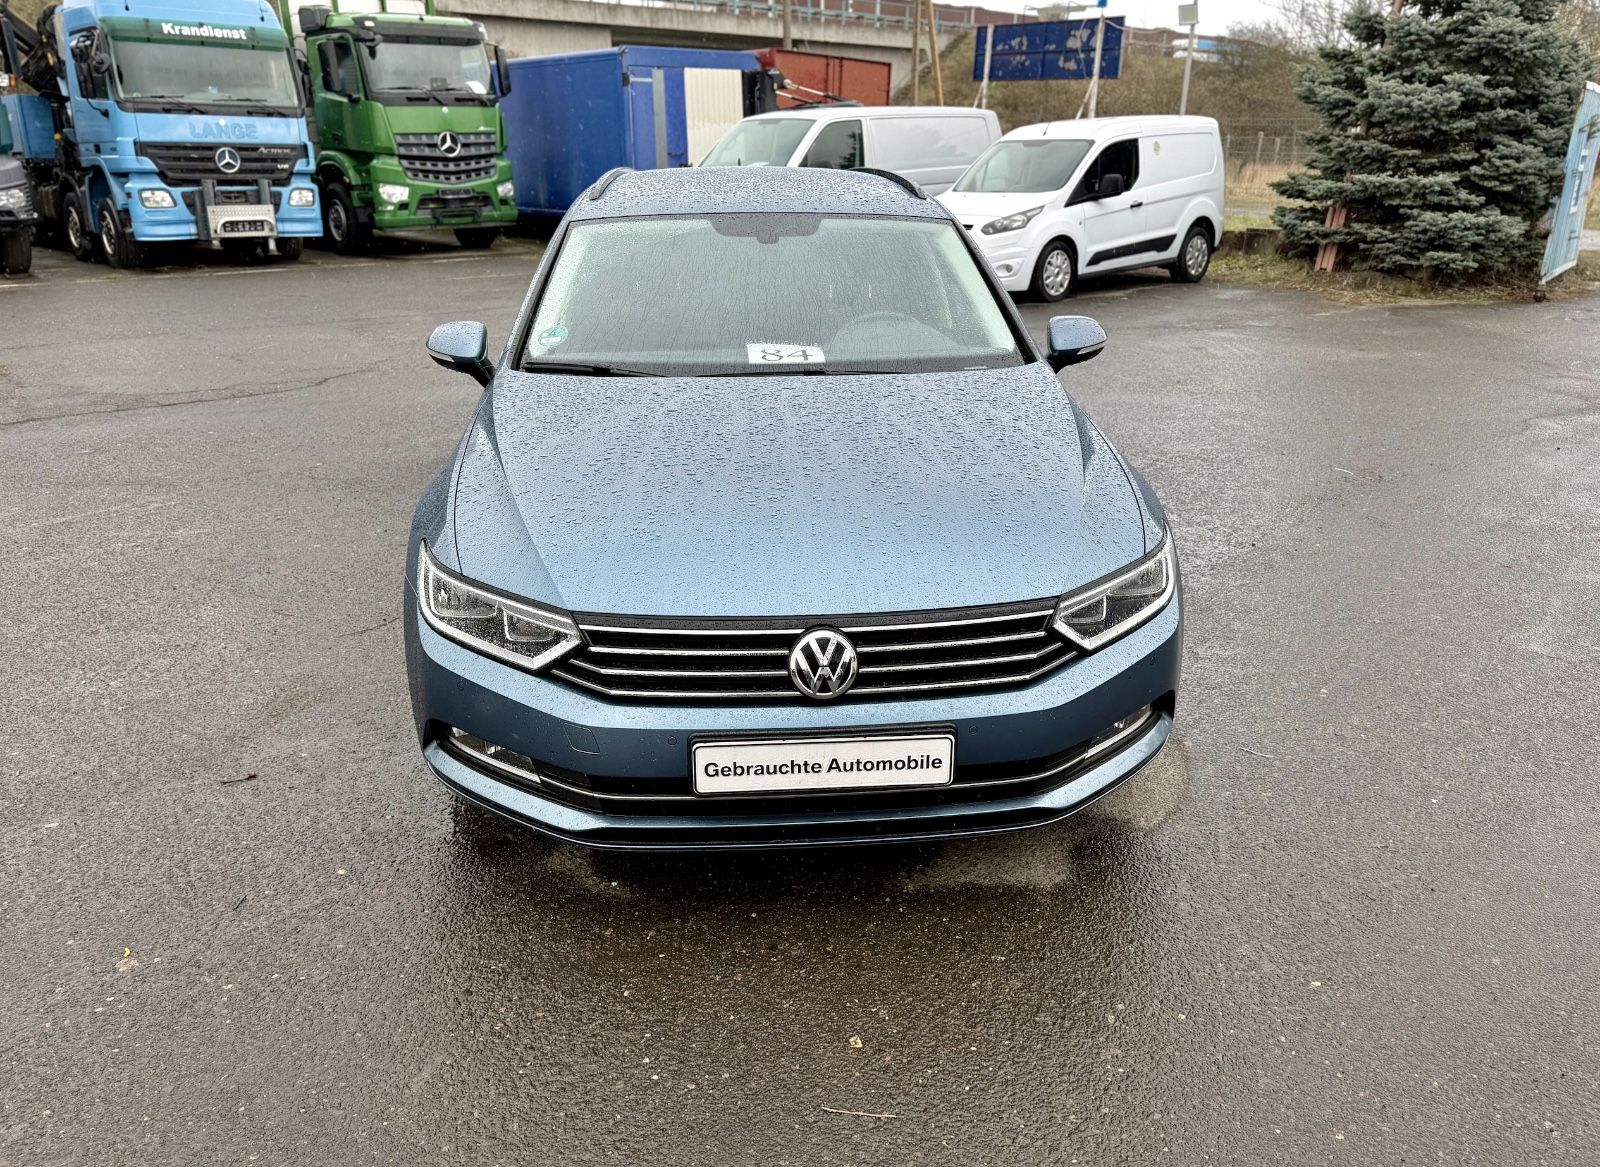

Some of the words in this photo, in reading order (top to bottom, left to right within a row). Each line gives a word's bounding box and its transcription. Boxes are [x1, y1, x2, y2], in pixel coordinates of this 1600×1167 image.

[161, 22, 247, 39] Krandienst
[189, 123, 258, 139] LANGE
[760, 349, 814, 361] 84
[793, 634, 855, 697] VW
[704, 759, 822, 778] Gebrauchte
[826, 754, 943, 773] Automobile
